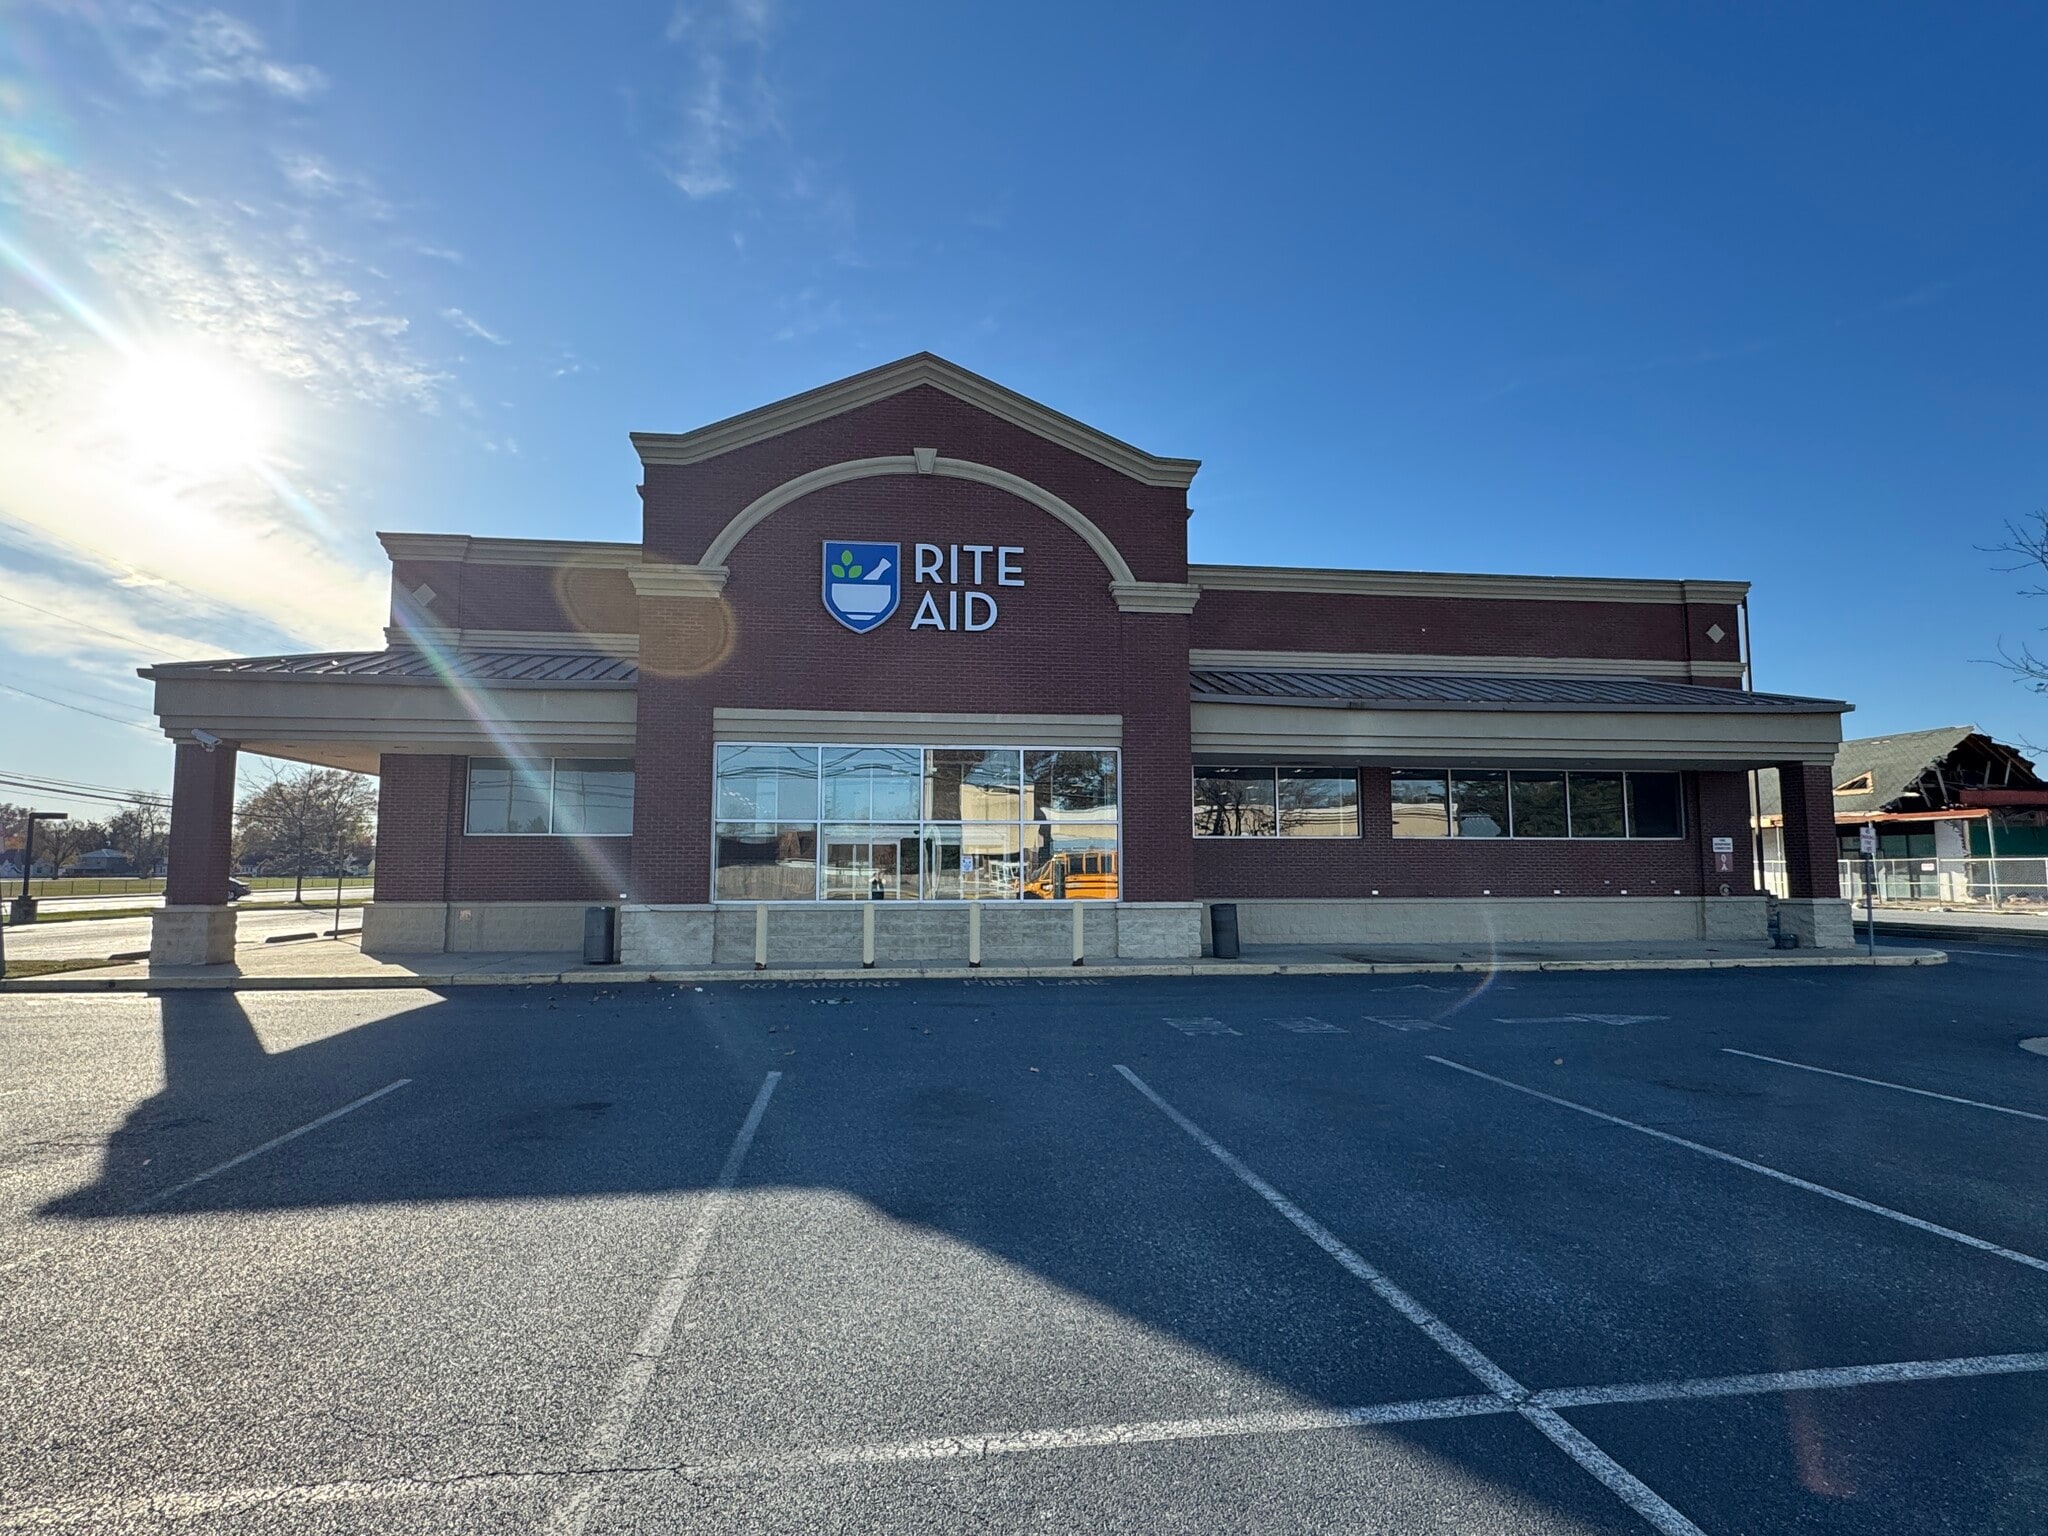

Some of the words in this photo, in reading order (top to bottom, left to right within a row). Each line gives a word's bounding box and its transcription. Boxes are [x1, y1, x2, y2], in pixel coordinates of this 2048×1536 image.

[915, 543, 1025, 587] RITE
[910, 590, 998, 632] AID
[739, 982, 777, 990] NO
[786, 980, 901, 989] PARKING
